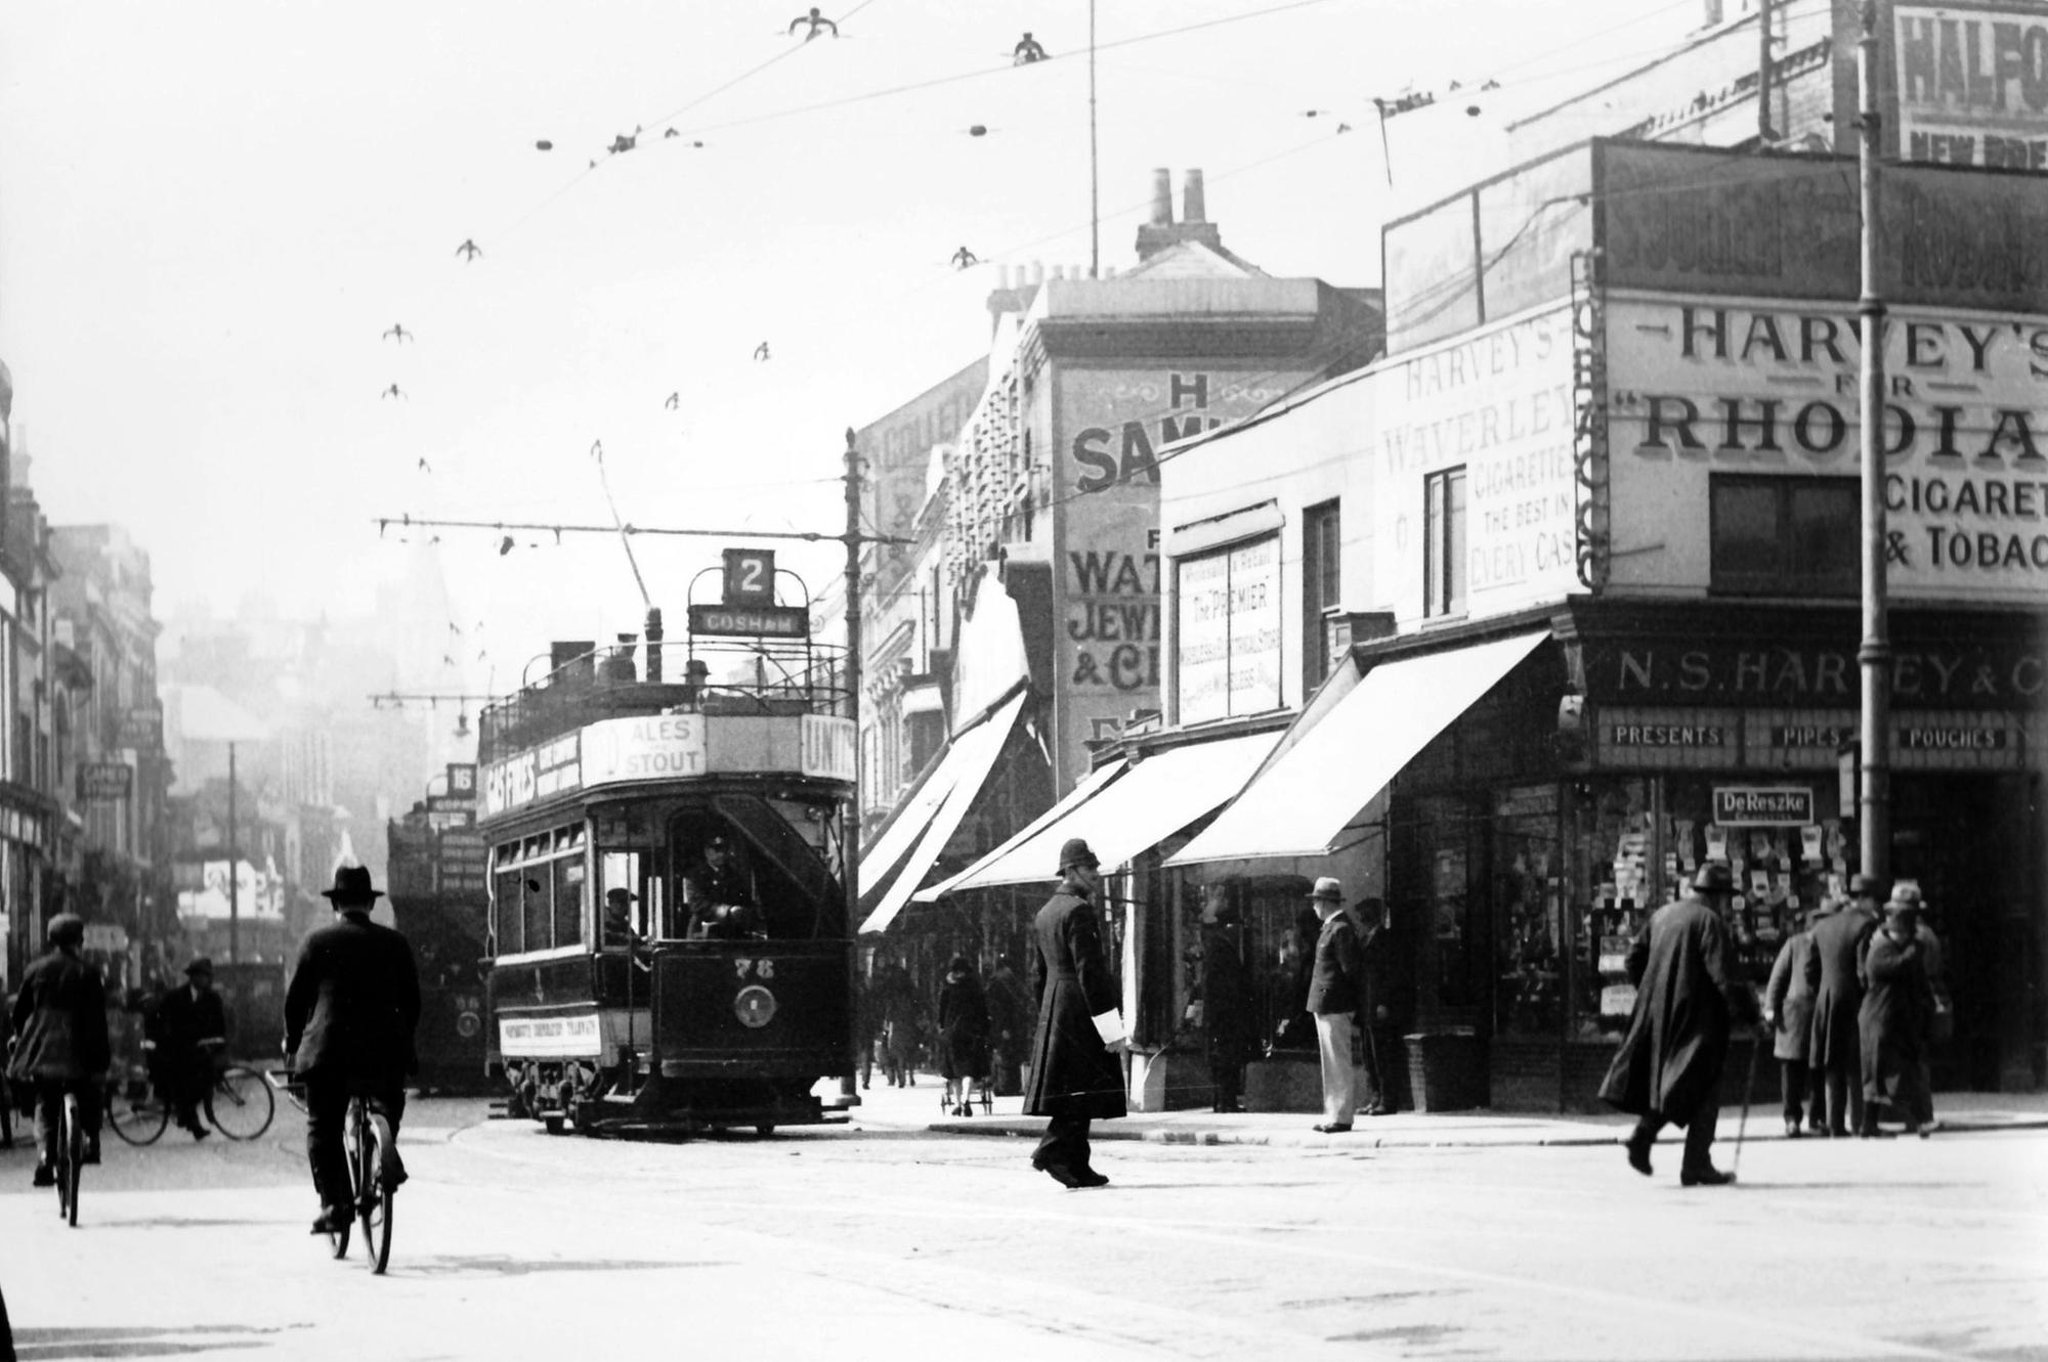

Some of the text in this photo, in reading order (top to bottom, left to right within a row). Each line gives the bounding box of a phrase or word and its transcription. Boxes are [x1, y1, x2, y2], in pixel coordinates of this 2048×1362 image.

[1910, 131, 1975, 166] NEW
[1406, 319, 1553, 401] HARVEY'S
[1171, 374, 1207, 408] H
[1835, 374, 1915, 397] FR
[1383, 384, 1573, 474] WAVERLEY
[1485, 494, 1570, 534] THE BEST IN
[1887, 532, 1909, 565] &
[741, 559, 763, 591] 2
[1471, 544, 1526, 587] EVERY
[707, 615, 792, 632] COSHAM
[1073, 652, 1102, 685] &
[1970, 664, 1997, 693] &
[631, 719, 691, 742] ALES
[1615, 726, 1720, 744] PRESENTS
[1783, 727, 1841, 745] PIPES
[1909, 728, 1996, 747] POUCHES
[626, 749, 699, 775] STOUT
[453, 768, 472, 789] 16
[734, 959, 774, 979] 78
